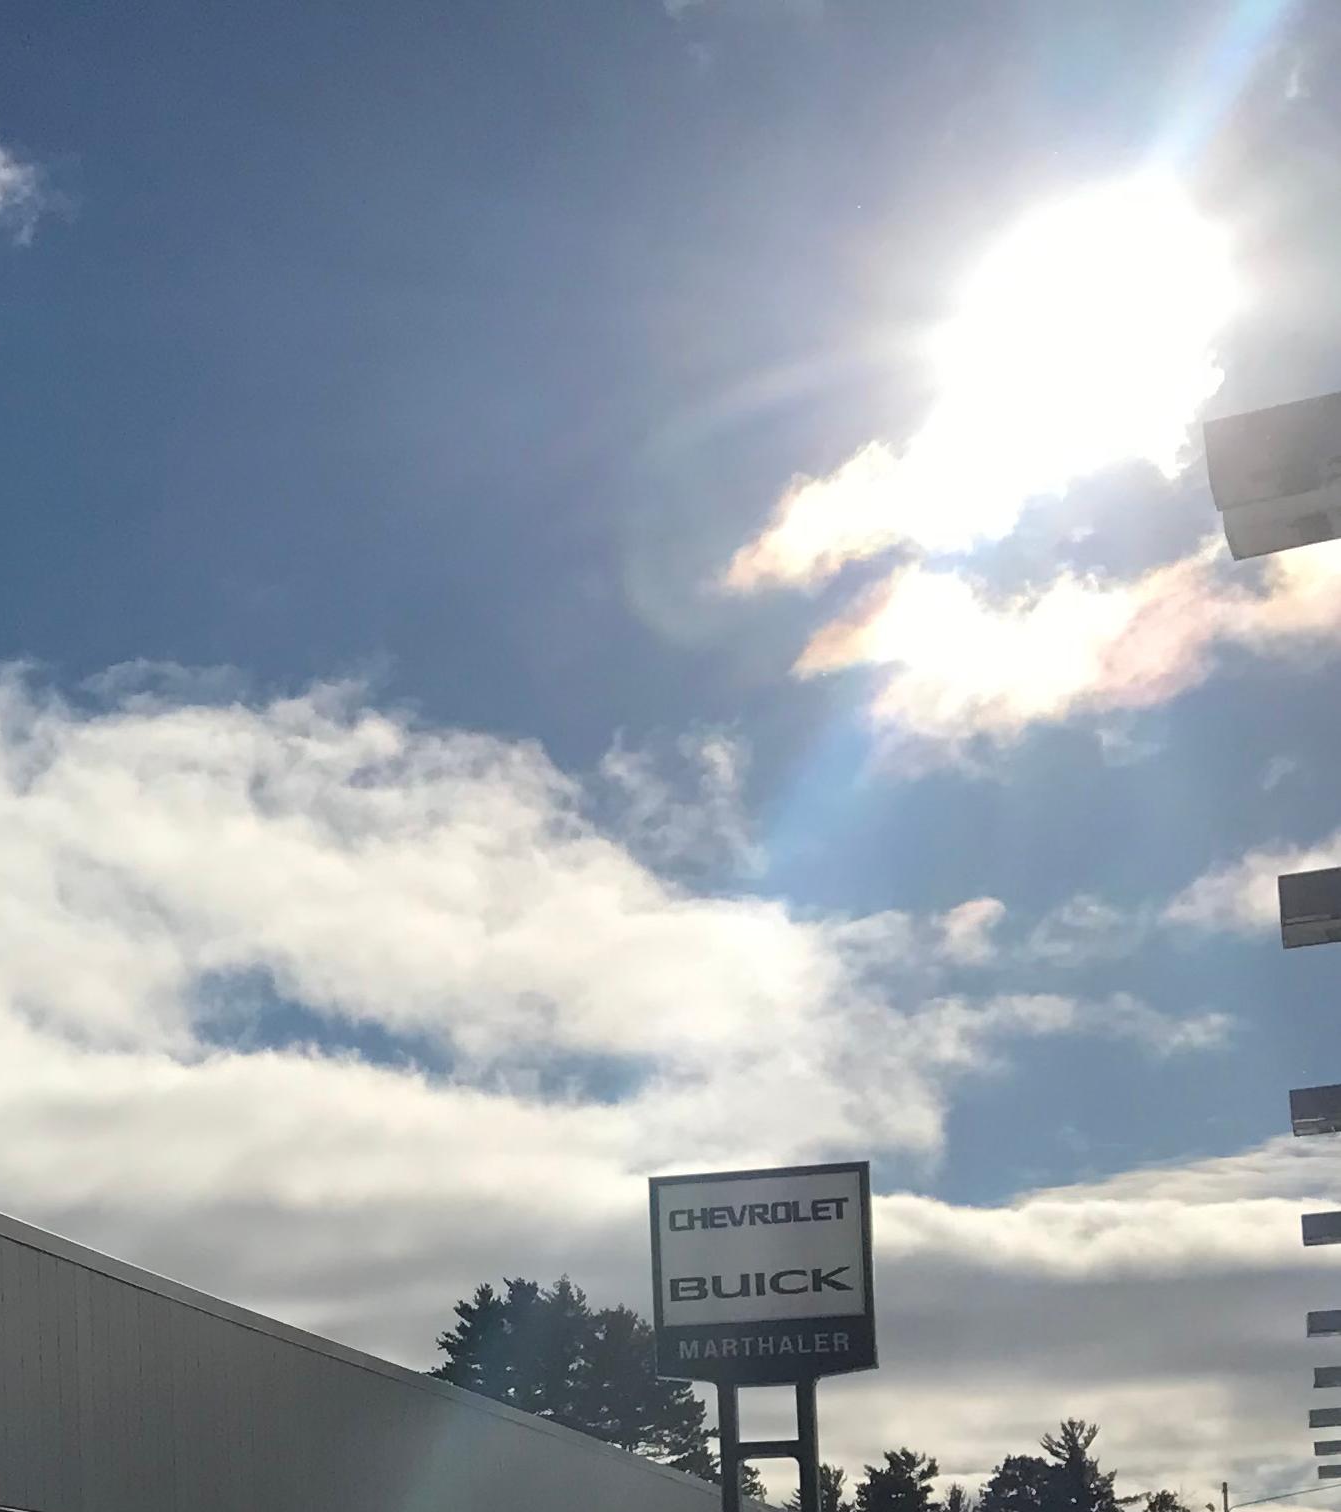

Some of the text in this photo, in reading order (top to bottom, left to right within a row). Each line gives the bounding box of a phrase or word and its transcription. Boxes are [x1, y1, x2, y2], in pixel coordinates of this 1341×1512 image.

[669, 1197, 849, 1232] CHEVROLET
[669, 1266, 854, 1302] BUICK
[678, 1332, 850, 1360] MARTHALER
